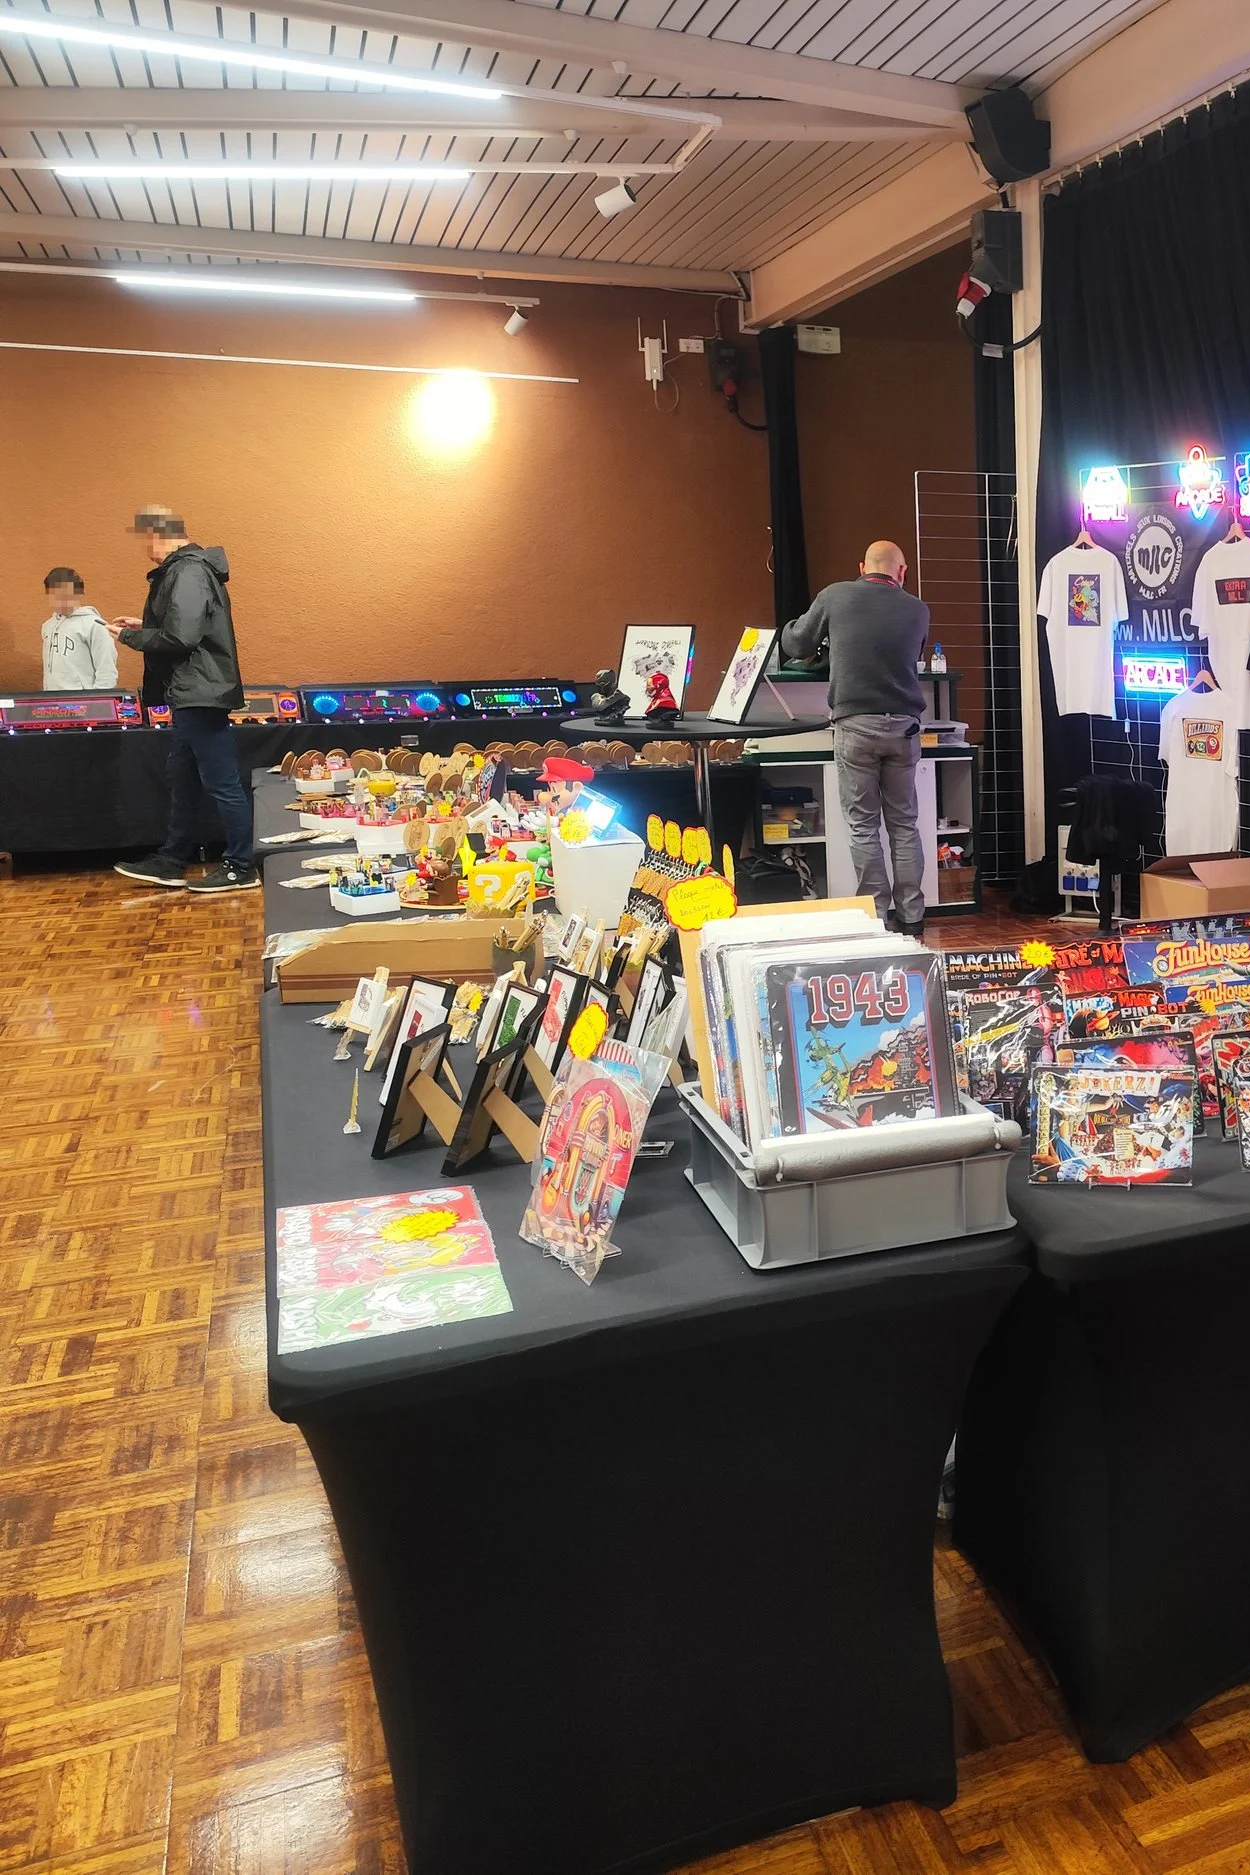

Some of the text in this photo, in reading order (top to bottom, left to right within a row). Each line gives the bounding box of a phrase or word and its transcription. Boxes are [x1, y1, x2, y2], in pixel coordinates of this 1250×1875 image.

[1137, 514, 1151, 533] JEUX
[1153, 514, 1176, 534] LOISIRS
[1225, 580, 1247, 590] EXTRA
[1126, 664, 1183, 684] ARCADE
[950, 952, 1032, 973] MACHIN
[806, 969, 909, 1025] 1943
[614, 1123, 632, 1149] DINER
